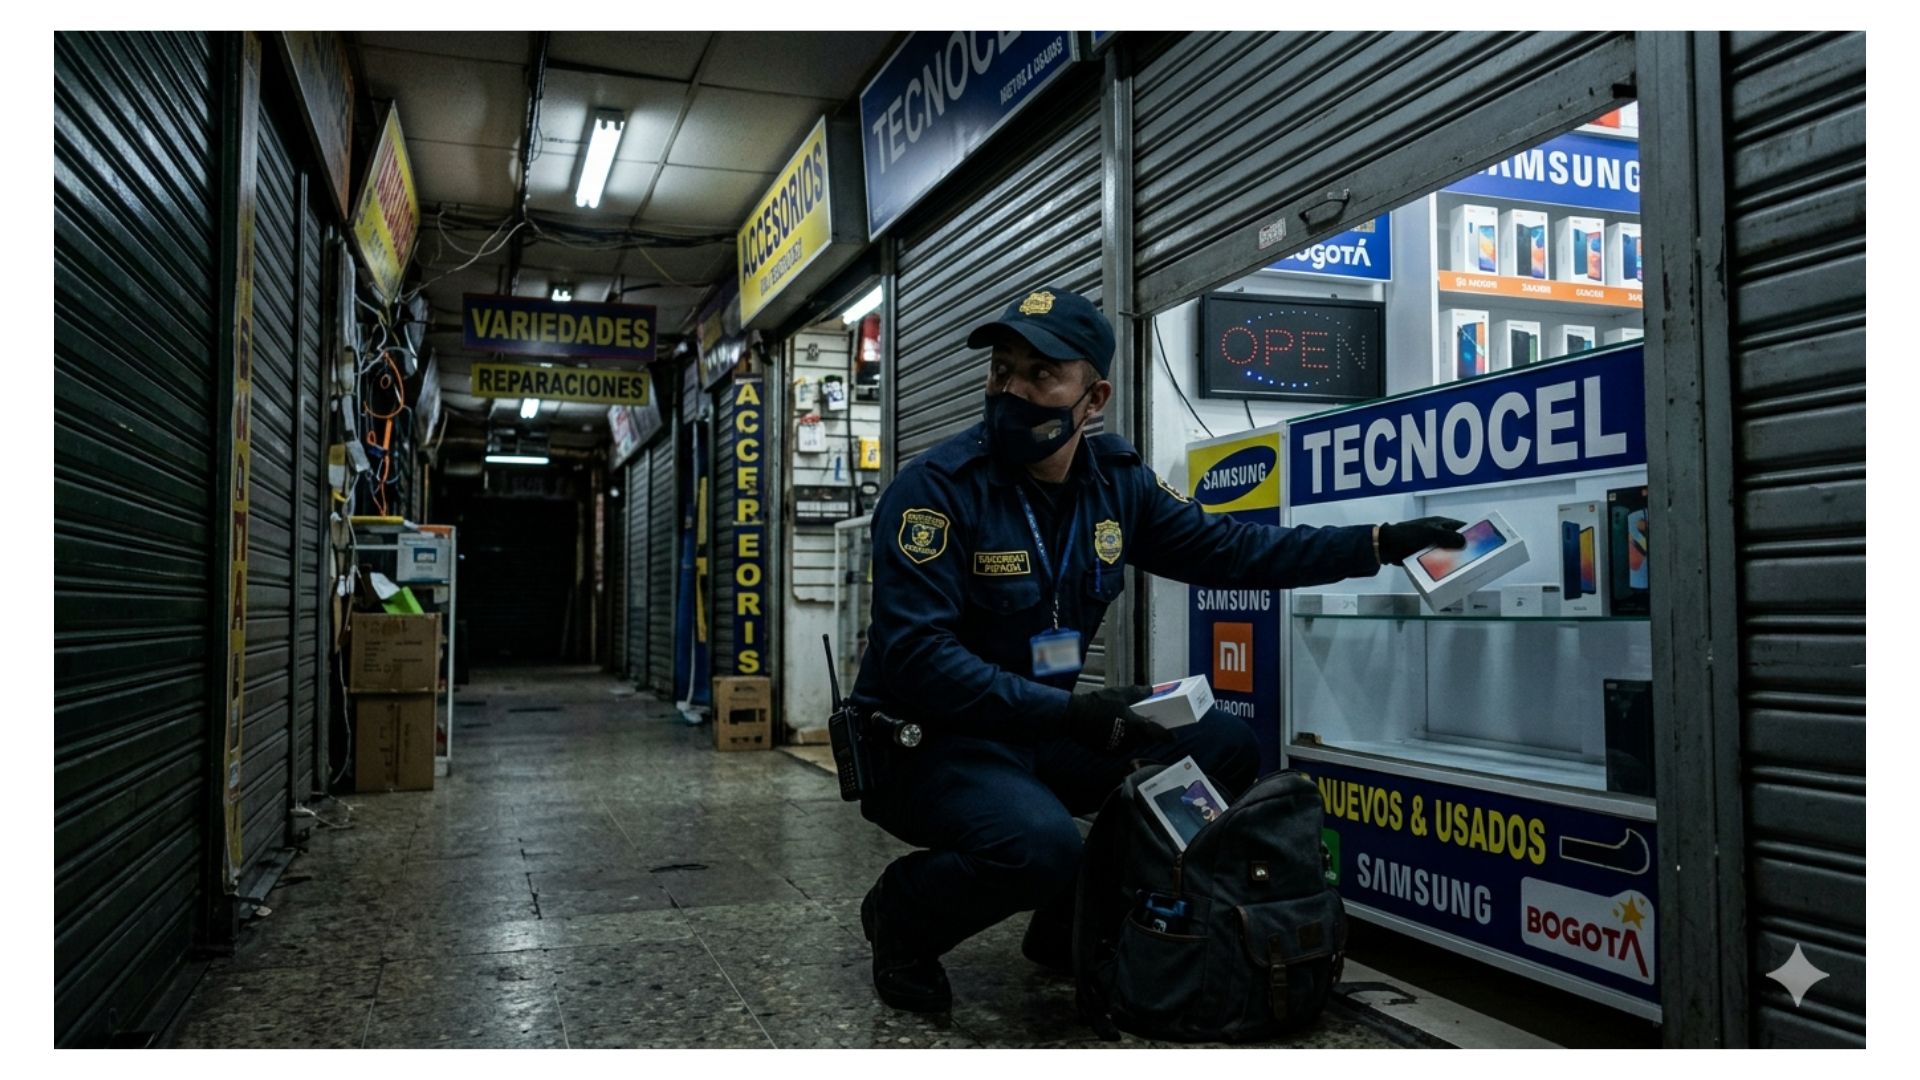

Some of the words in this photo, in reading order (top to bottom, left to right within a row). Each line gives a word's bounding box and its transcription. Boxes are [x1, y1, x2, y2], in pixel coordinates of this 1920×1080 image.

[872, 31, 1022, 175] TECNOC
[1474, 149, 1640, 193] AMSUNG
[742, 141, 824, 285] ACCESORIOS
[471, 308, 650, 349] VARIEDADES
[1220, 326, 1367, 370] OPEN
[478, 368, 643, 400] REPARACIONES
[1302, 375, 1628, 494] TECNOCEL
[1203, 461, 1267, 491] SAMSUNG
[1197, 589, 1271, 612] SAMSUNG
[1318, 776, 1404, 831] NUEVOS
[1410, 794, 1427, 837] &
[1435, 800, 1547, 865] USADOS
[1356, 852, 1492, 925] SAMSUNG
